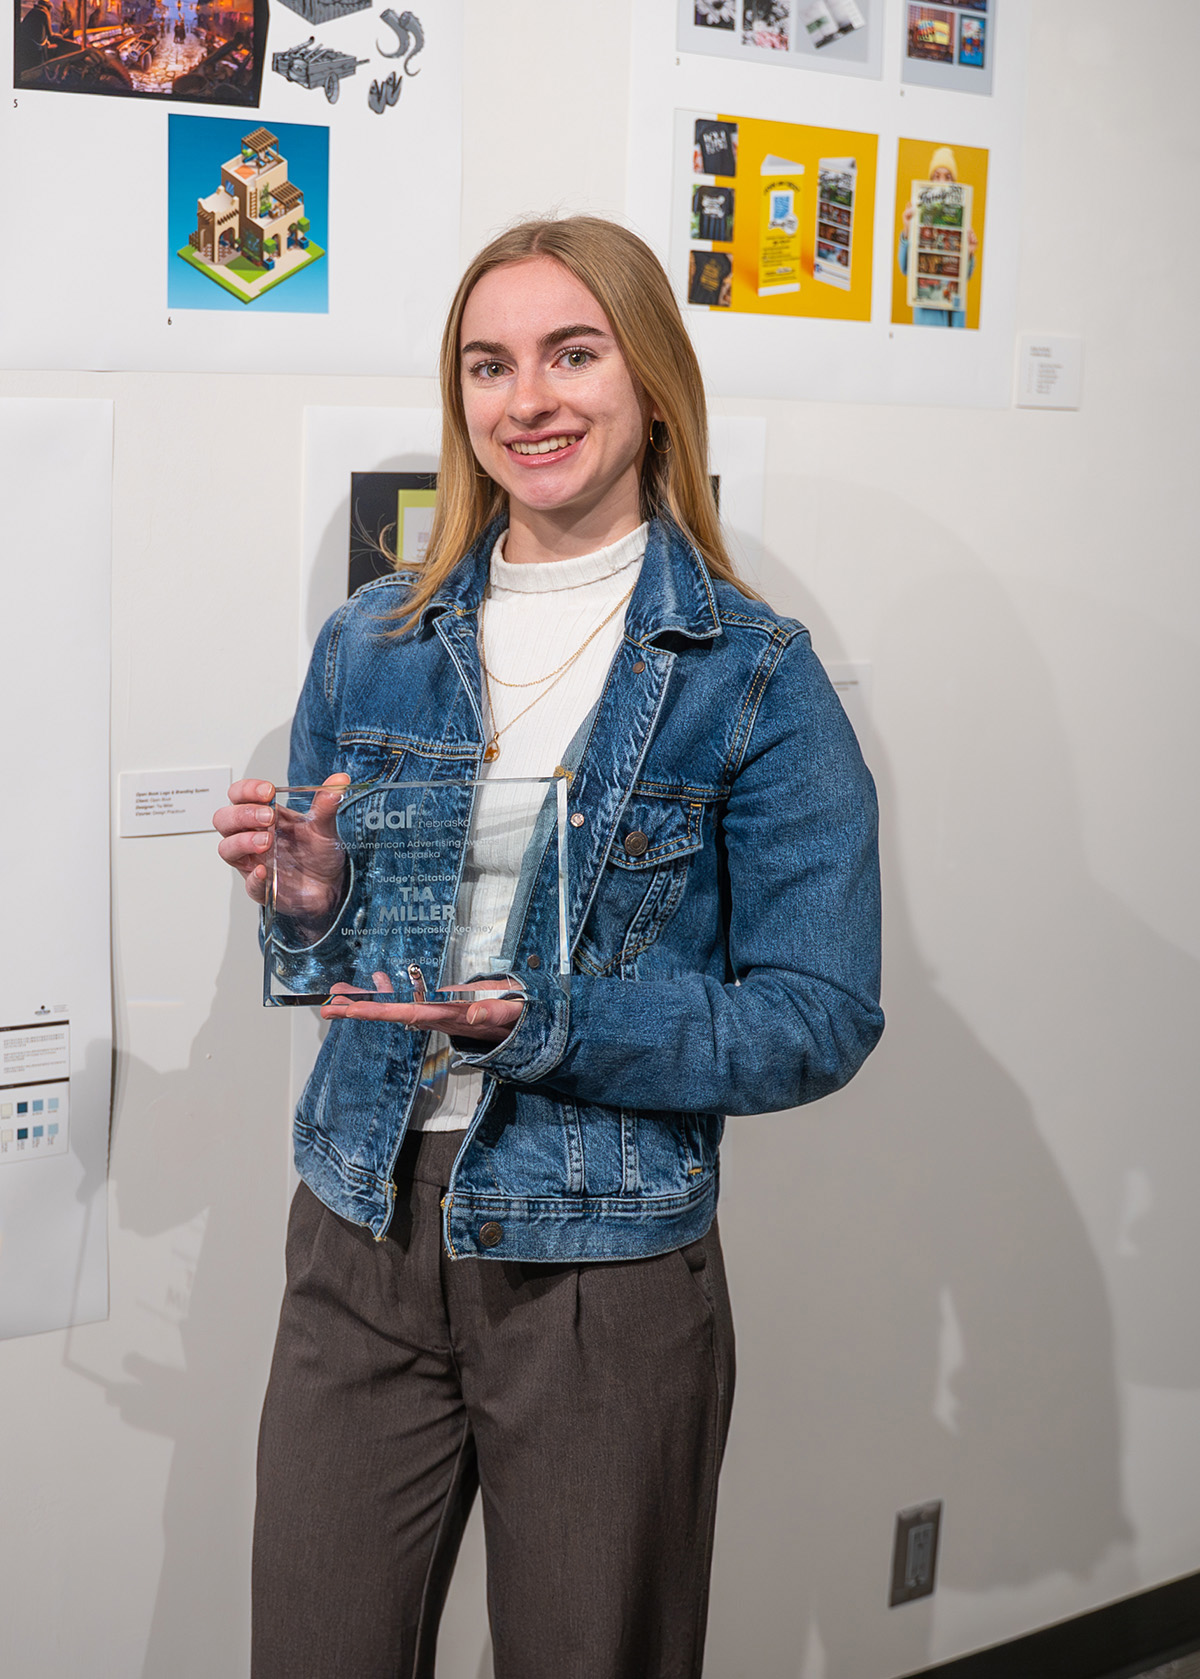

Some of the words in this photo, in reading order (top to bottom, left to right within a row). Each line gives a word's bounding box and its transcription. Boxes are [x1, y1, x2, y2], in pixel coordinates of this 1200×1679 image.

[13, 99, 18, 109] 5
[167, 317, 173, 326] 6
[365, 804, 417, 830] aaf
[418, 819, 470, 828] nebraska
[406, 839, 461, 848] Advertising
[463, 838, 501, 846] Aars
[378, 874, 415, 884] Judge's
[417, 873, 457, 882] Citation
[399, 887, 435, 902] TIA
[379, 905, 456, 922] MILLER
[341, 926, 390, 936] University
[392, 926, 401, 934] of
[453, 925, 494, 934] Keaney
